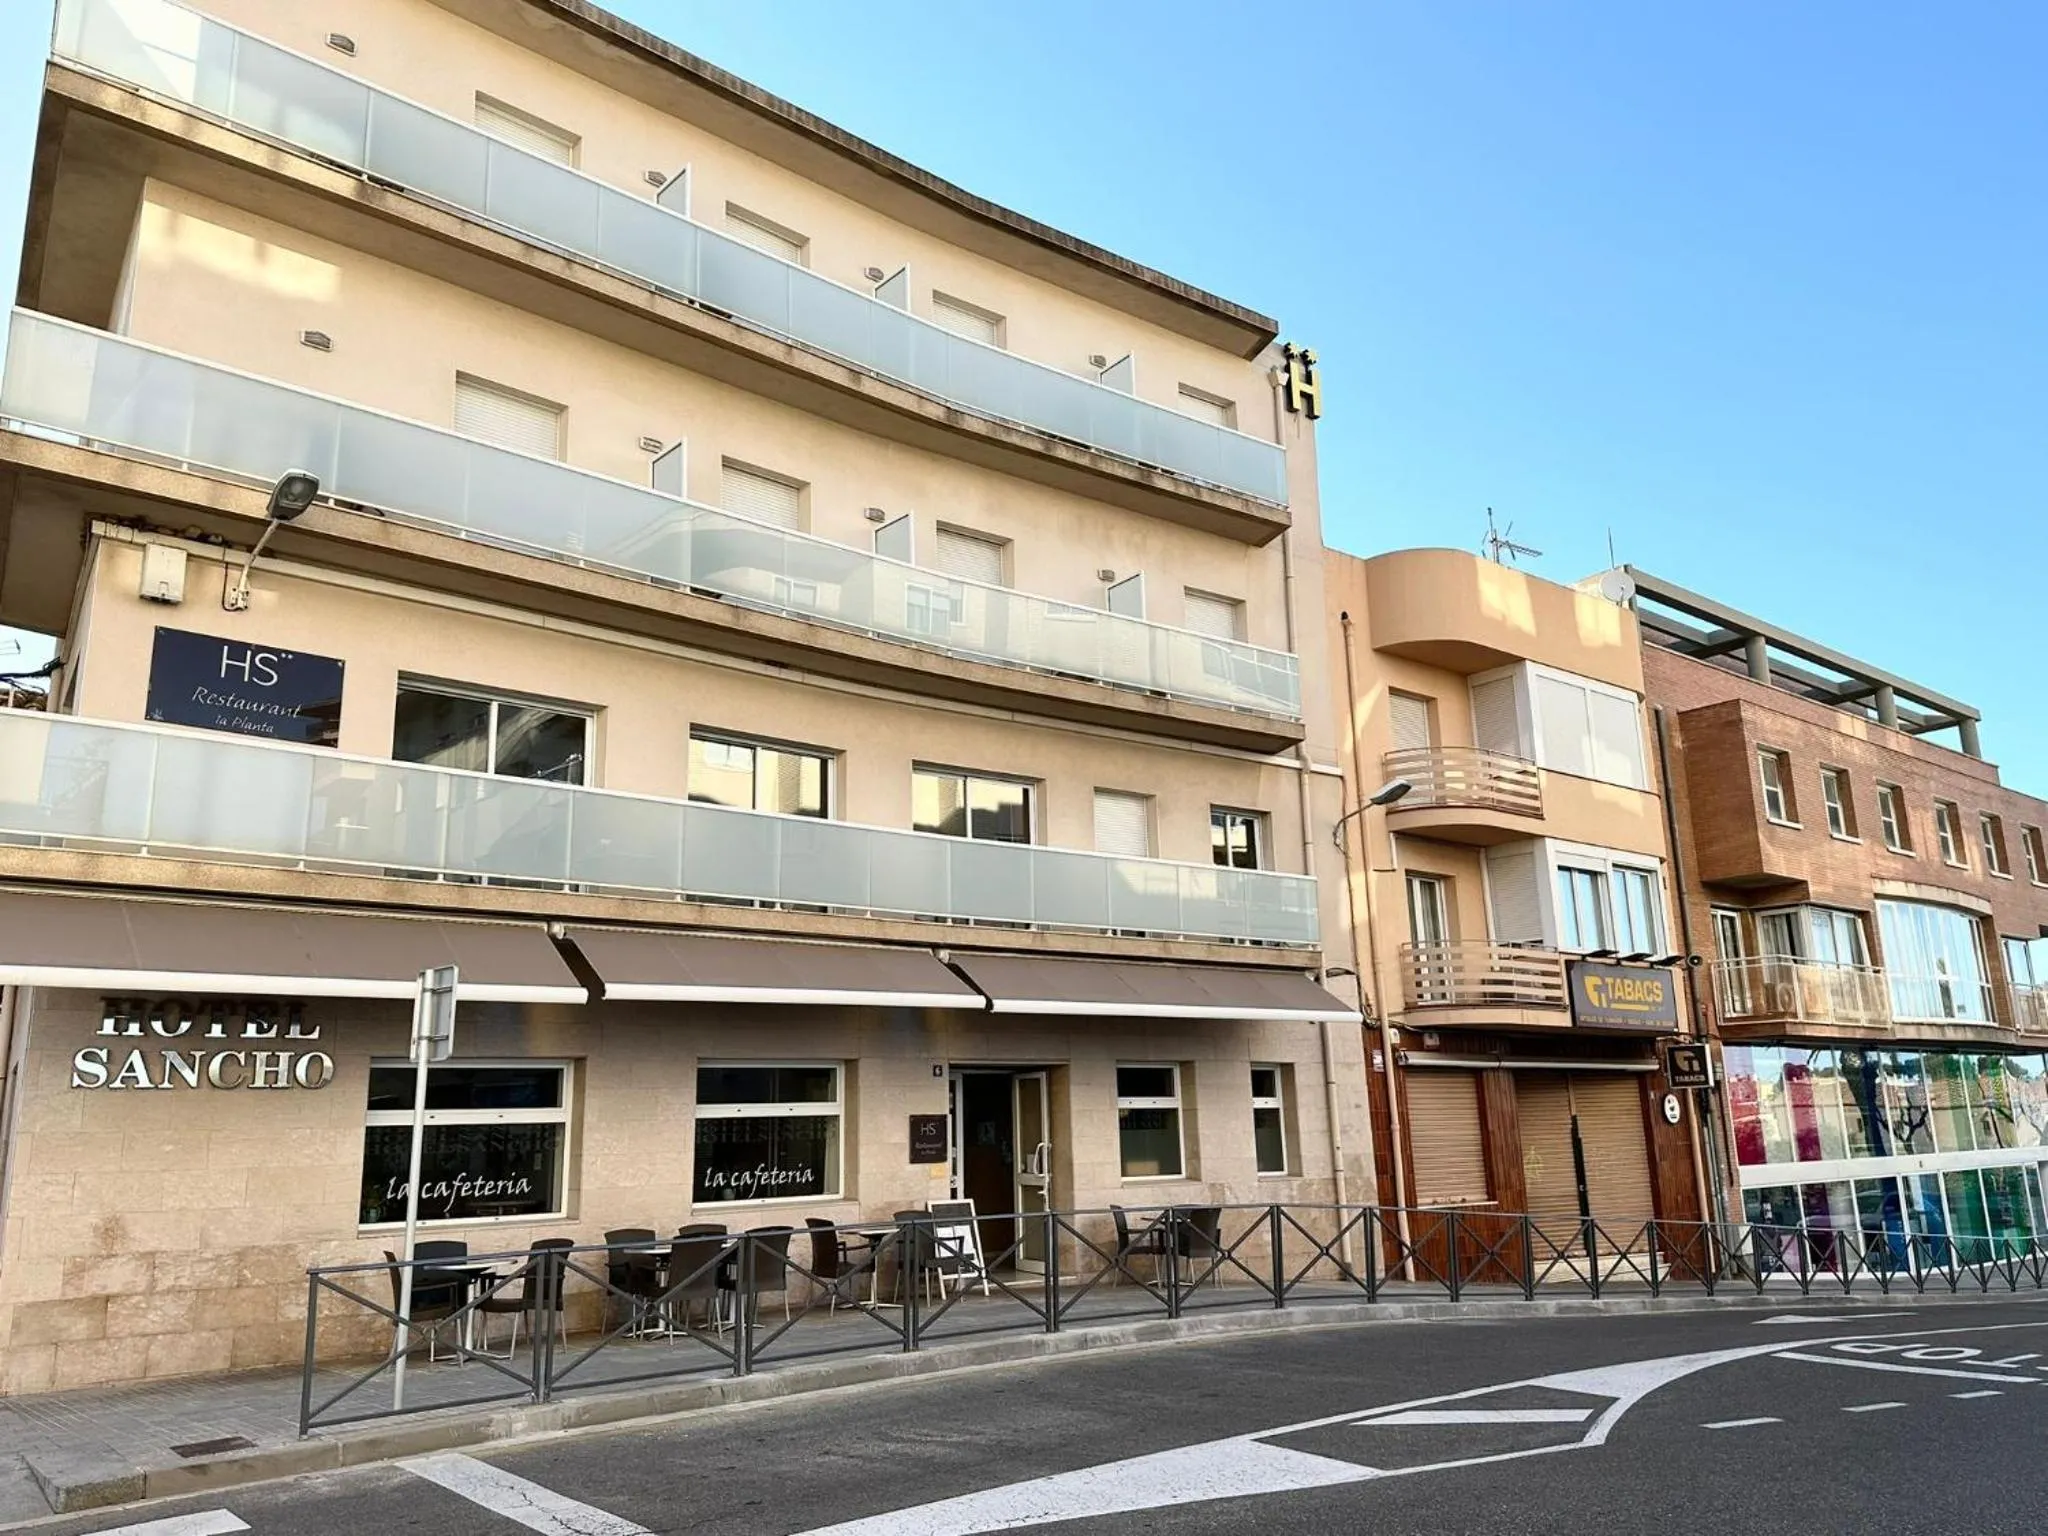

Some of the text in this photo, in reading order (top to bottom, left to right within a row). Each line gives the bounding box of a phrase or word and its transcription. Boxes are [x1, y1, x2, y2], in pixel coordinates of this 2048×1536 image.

[192, 686, 302, 719] Restaurant
[231, 715, 274, 734] Planta
[1605, 977, 1663, 1002] TABACS
[96, 996, 321, 1041] HOTEL
[71, 1047, 335, 1090] SANCHO
[386, 1172, 532, 1213] la cafeteria
[704, 1163, 815, 1200] la cafeteria
